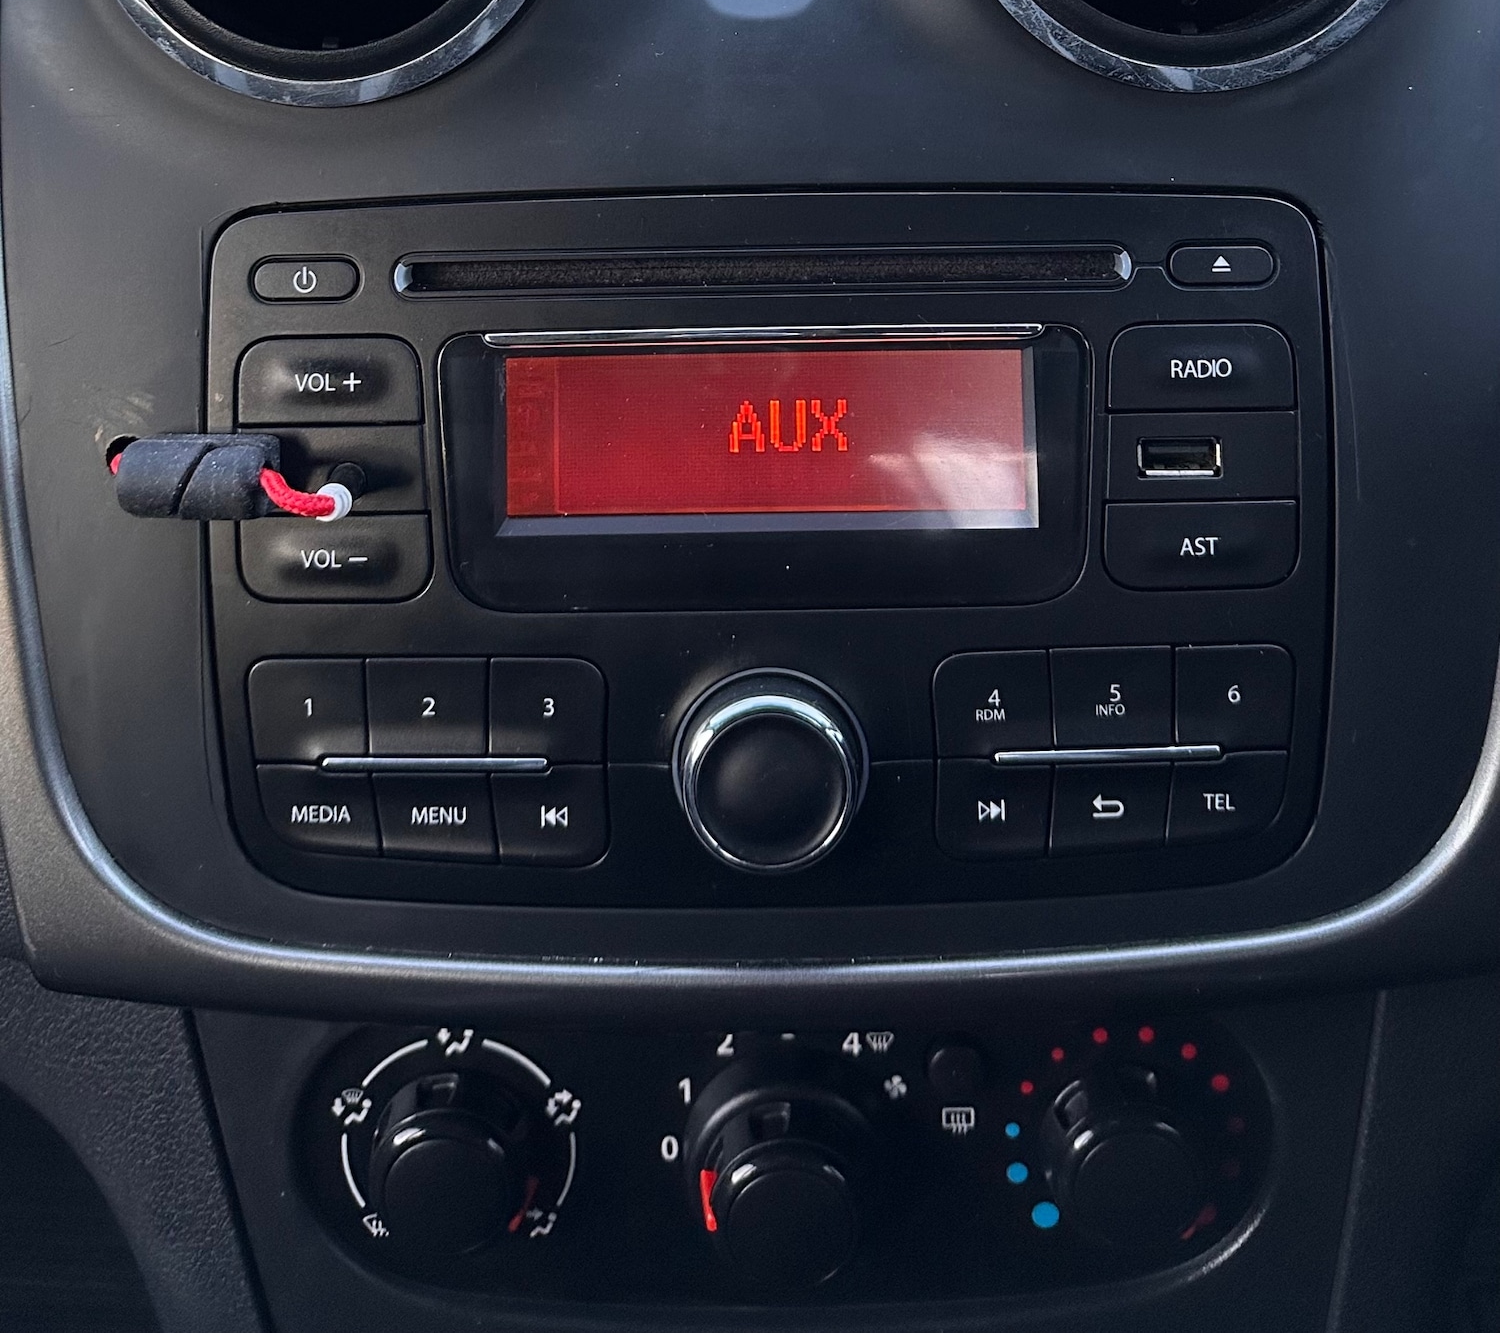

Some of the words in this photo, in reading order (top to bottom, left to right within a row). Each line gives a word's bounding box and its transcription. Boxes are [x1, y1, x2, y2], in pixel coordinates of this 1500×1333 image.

[1170, 358, 1233, 378] RADIO
[295, 374, 335, 392] VOL
[729, 398, 848, 453] AUX
[1180, 537, 1219, 556] AST
[301, 549, 341, 568] VOL
[987, 688, 1001, 707] 4
[1109, 684, 1121, 703] 5
[1227, 685, 1241, 704] 6
[302, 698, 313, 717] 1
[421, 697, 436, 716] 2
[542, 698, 555, 716] 3
[975, 708, 1006, 722] RDM
[1095, 703, 1126, 717] INFO
[1203, 792, 1235, 812] TEL
[290, 805, 351, 825] MEDIA
[411, 806, 468, 826] MENU
[842, 1031, 862, 1058] 4
[678, 1077, 692, 1105] 1
[661, 1135, 679, 1162] 0
